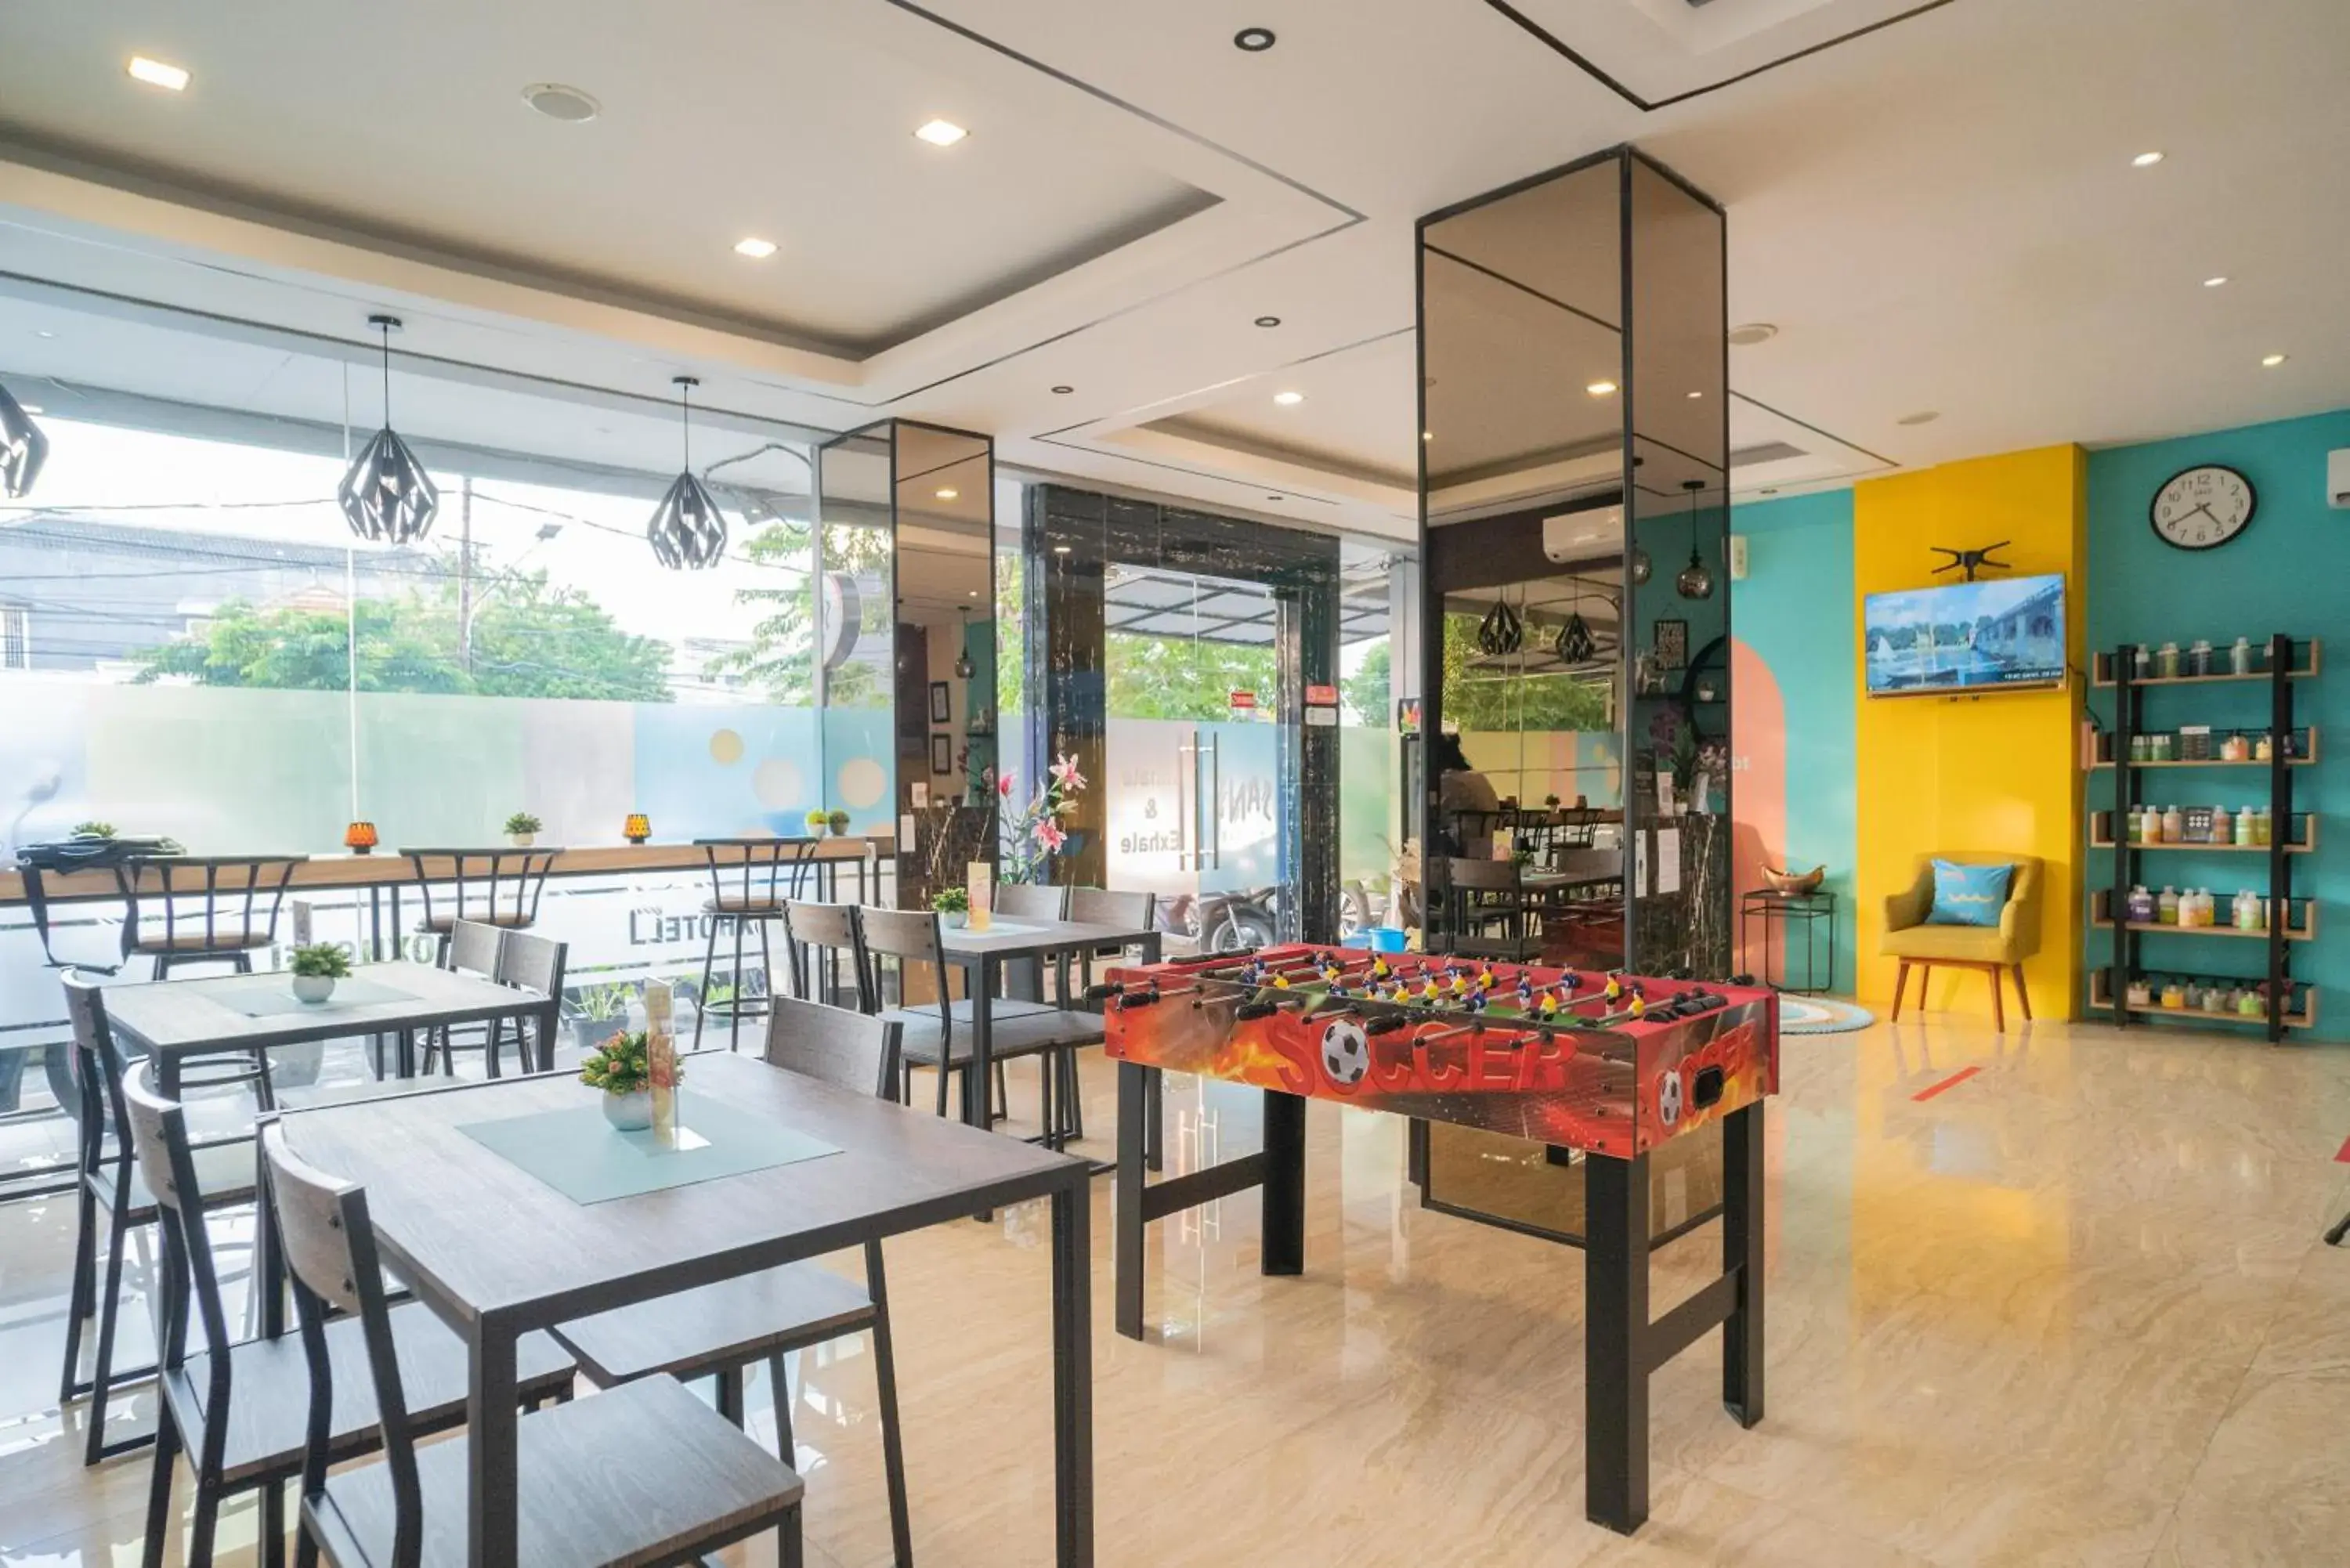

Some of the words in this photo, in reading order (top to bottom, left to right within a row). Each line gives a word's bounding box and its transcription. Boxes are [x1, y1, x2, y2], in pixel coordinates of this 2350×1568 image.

[2197, 474, 2211, 485] 12
[2182, 480, 2193, 491] 11
[2231, 484, 2240, 496] 2
[2168, 492, 2182, 502] 10
[2162, 506, 2171, 518] 9
[2180, 529, 2188, 540] 7
[2196, 530, 2206, 542] 6
[2215, 526, 2224, 537] 5
[1264, 1009, 1578, 1096] SOCCER
